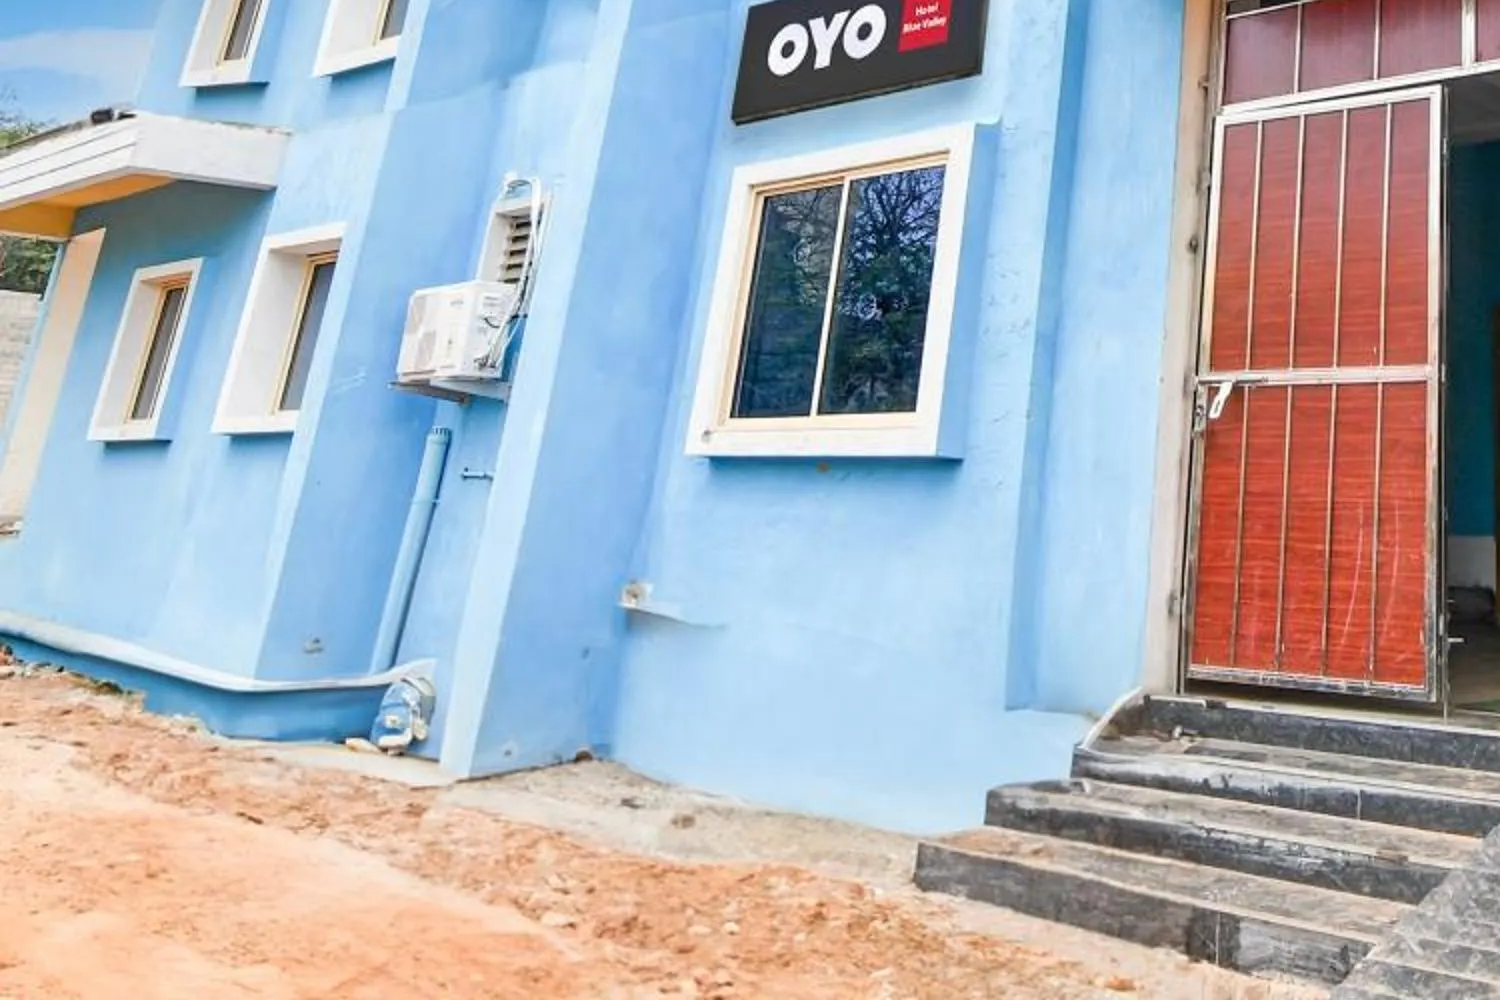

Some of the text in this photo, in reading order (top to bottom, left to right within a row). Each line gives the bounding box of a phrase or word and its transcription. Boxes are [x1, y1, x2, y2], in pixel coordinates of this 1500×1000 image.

[915, 1, 939, 16] Hotel
[921, 16, 947, 29] Valley
[767, 4, 887, 76] OYO
